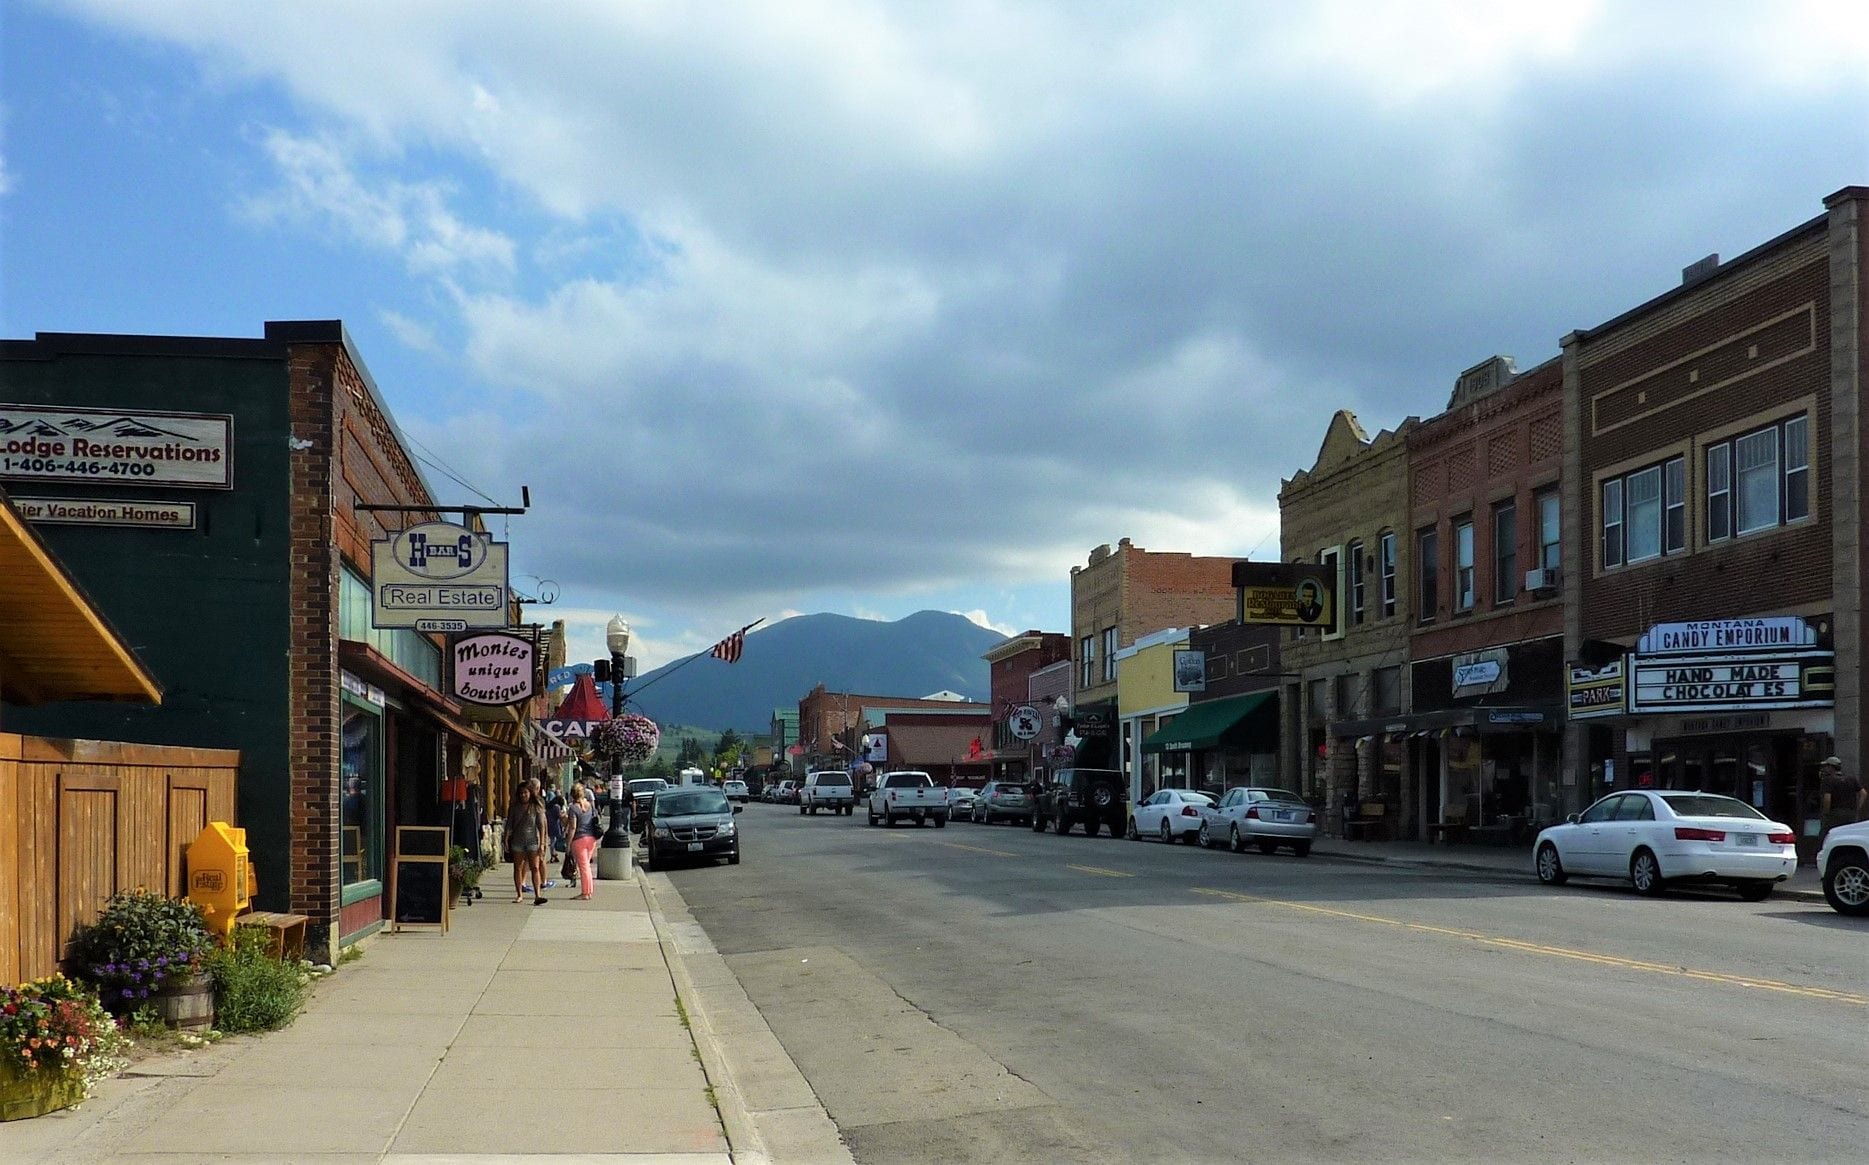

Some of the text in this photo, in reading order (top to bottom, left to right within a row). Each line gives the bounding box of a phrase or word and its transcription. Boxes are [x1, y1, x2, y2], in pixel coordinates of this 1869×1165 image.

[73, 438, 221, 462] Reservations
[4, 458, 155, 476] 1-406-446-4700
[47, 504, 116, 518] Vacation
[122, 507, 179, 521] Homes
[409, 533, 472, 568] H BAR S
[391, 589, 495, 606] Real Estate
[420, 622, 463, 630] 446-3535
[1687, 620, 1764, 629] MONTANA
[1663, 627, 1790, 649] CANDY EMPORIUM
[457, 641, 529, 662] Monies
[468, 663, 519, 678] unique
[549, 671, 570, 685] RED
[1666, 664, 1781, 683] HAND MADE
[460, 680, 527, 701] boutique
[1582, 688, 1611, 703] PARK
[546, 720, 600, 738] CAF
